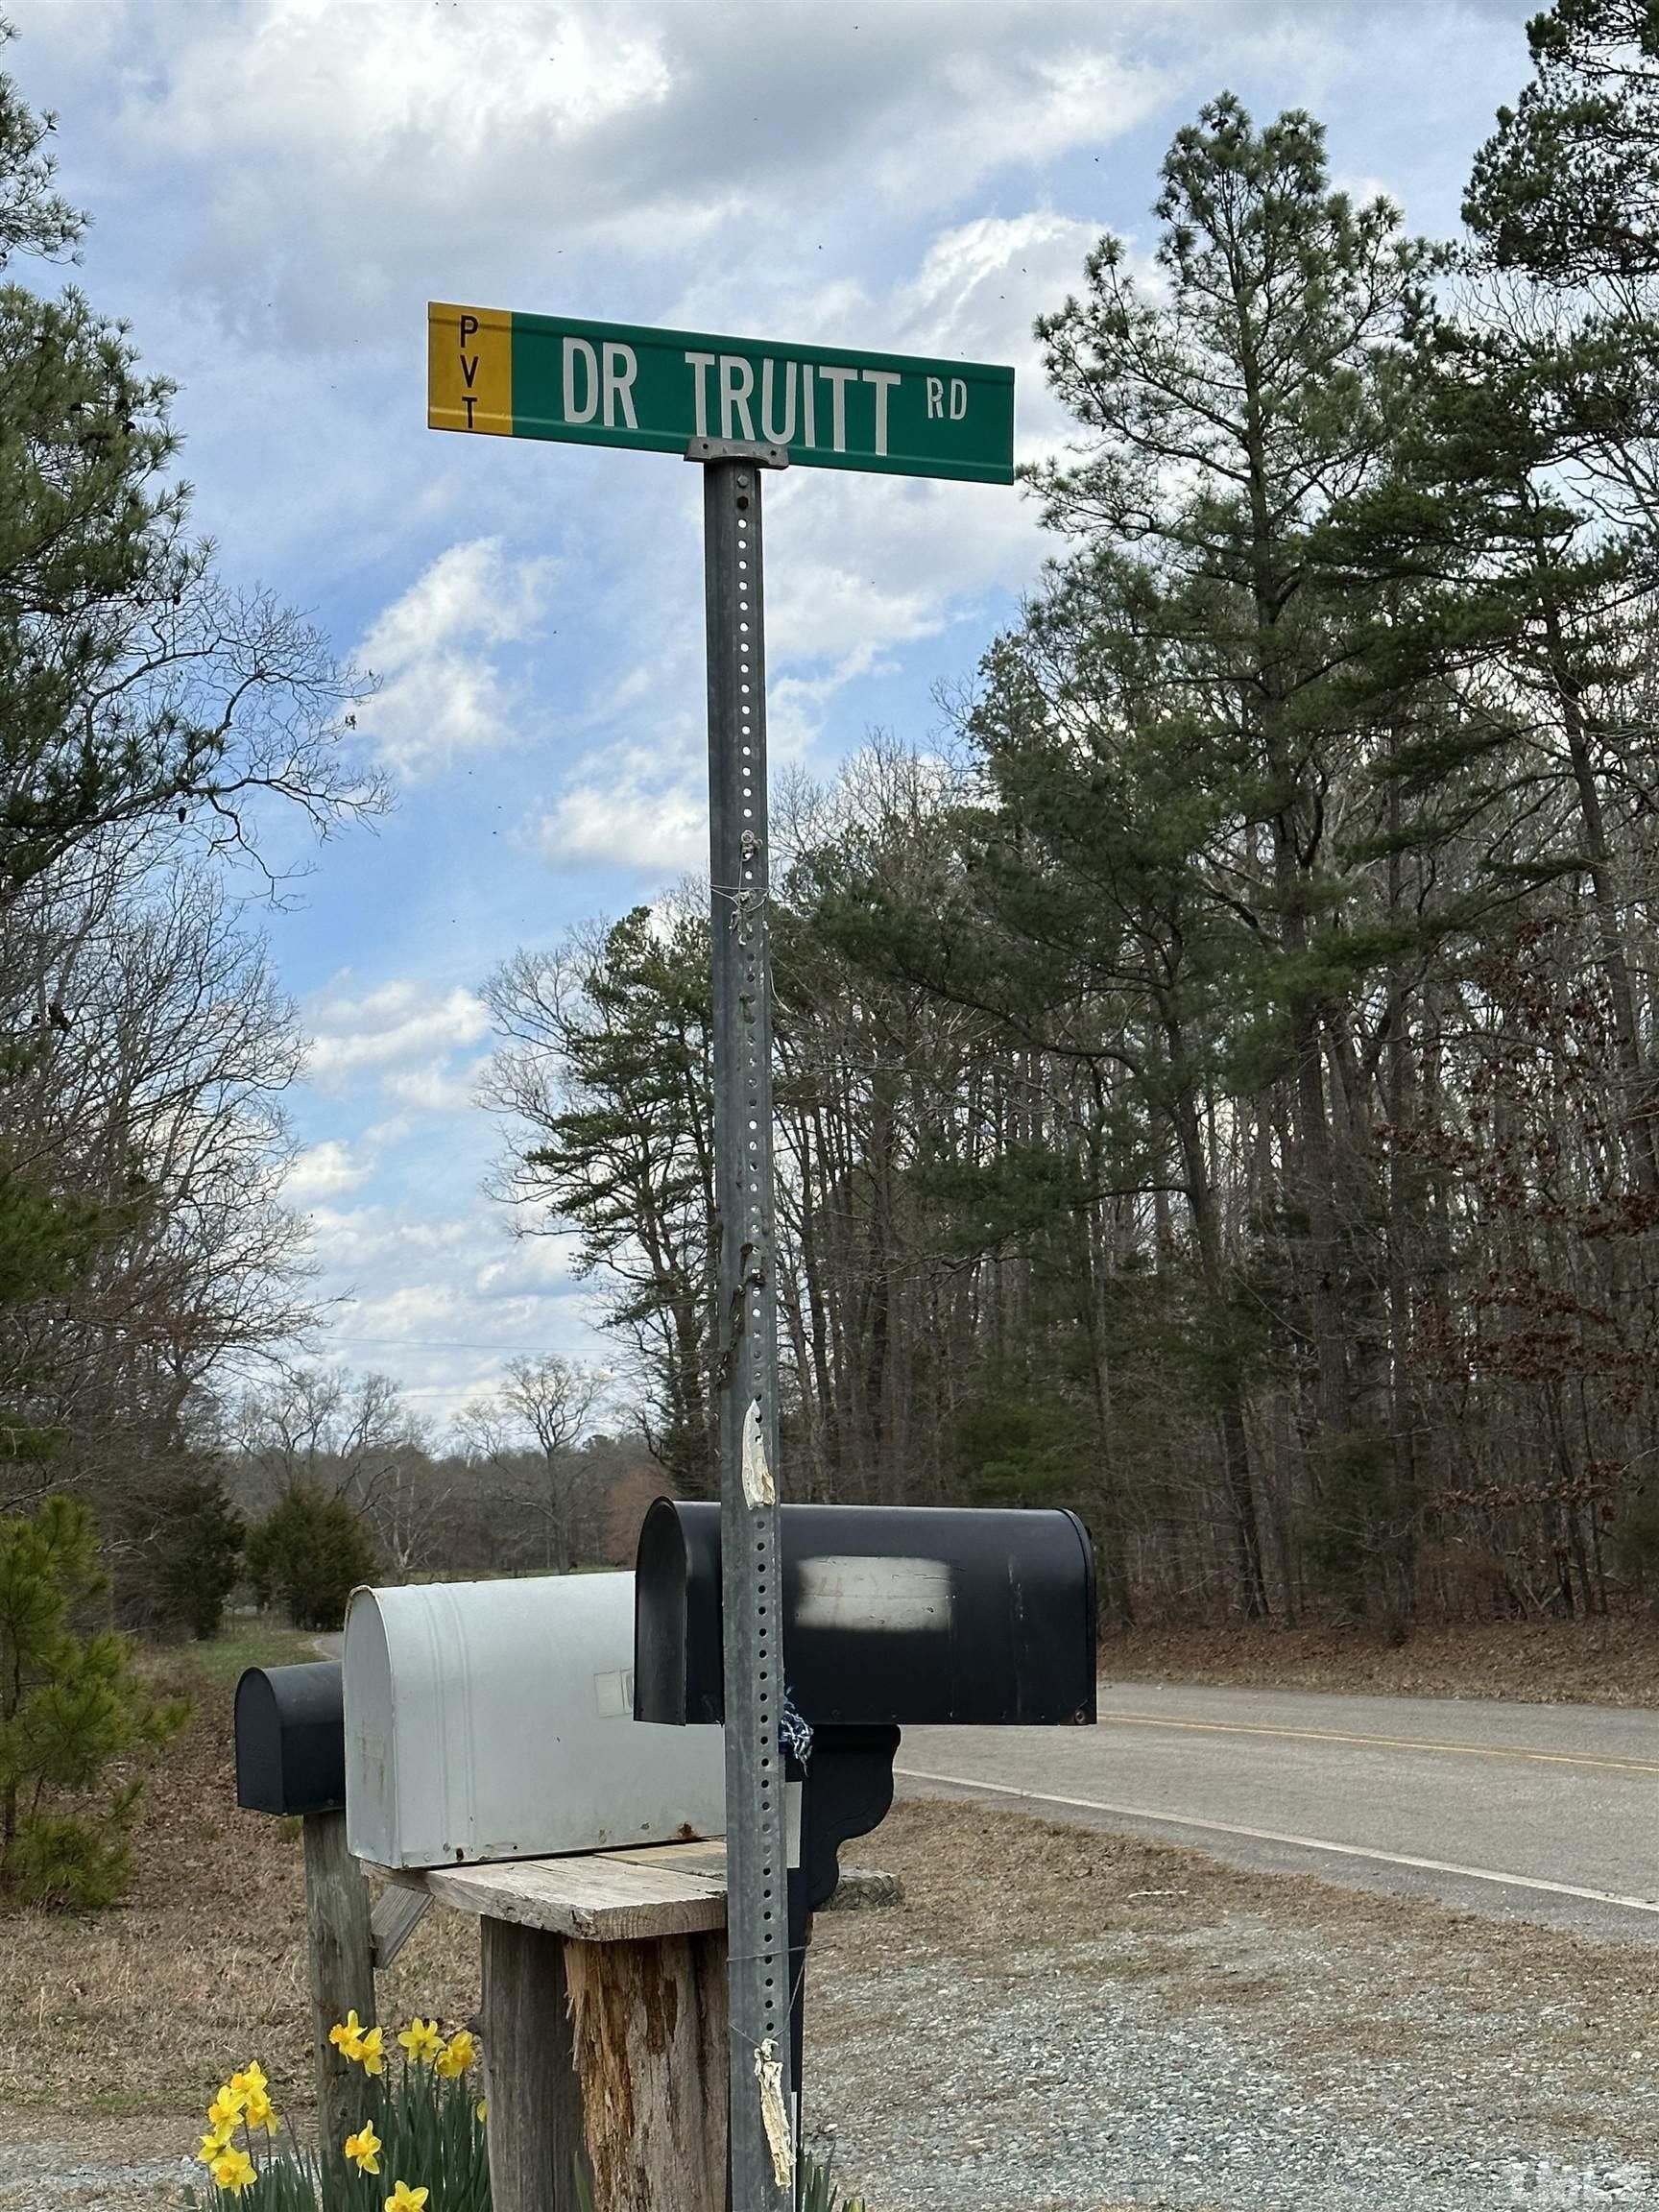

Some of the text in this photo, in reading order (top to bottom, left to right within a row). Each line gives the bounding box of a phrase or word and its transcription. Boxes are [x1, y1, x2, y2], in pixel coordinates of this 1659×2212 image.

[563, 336, 968, 456] DR TRUITT RD
